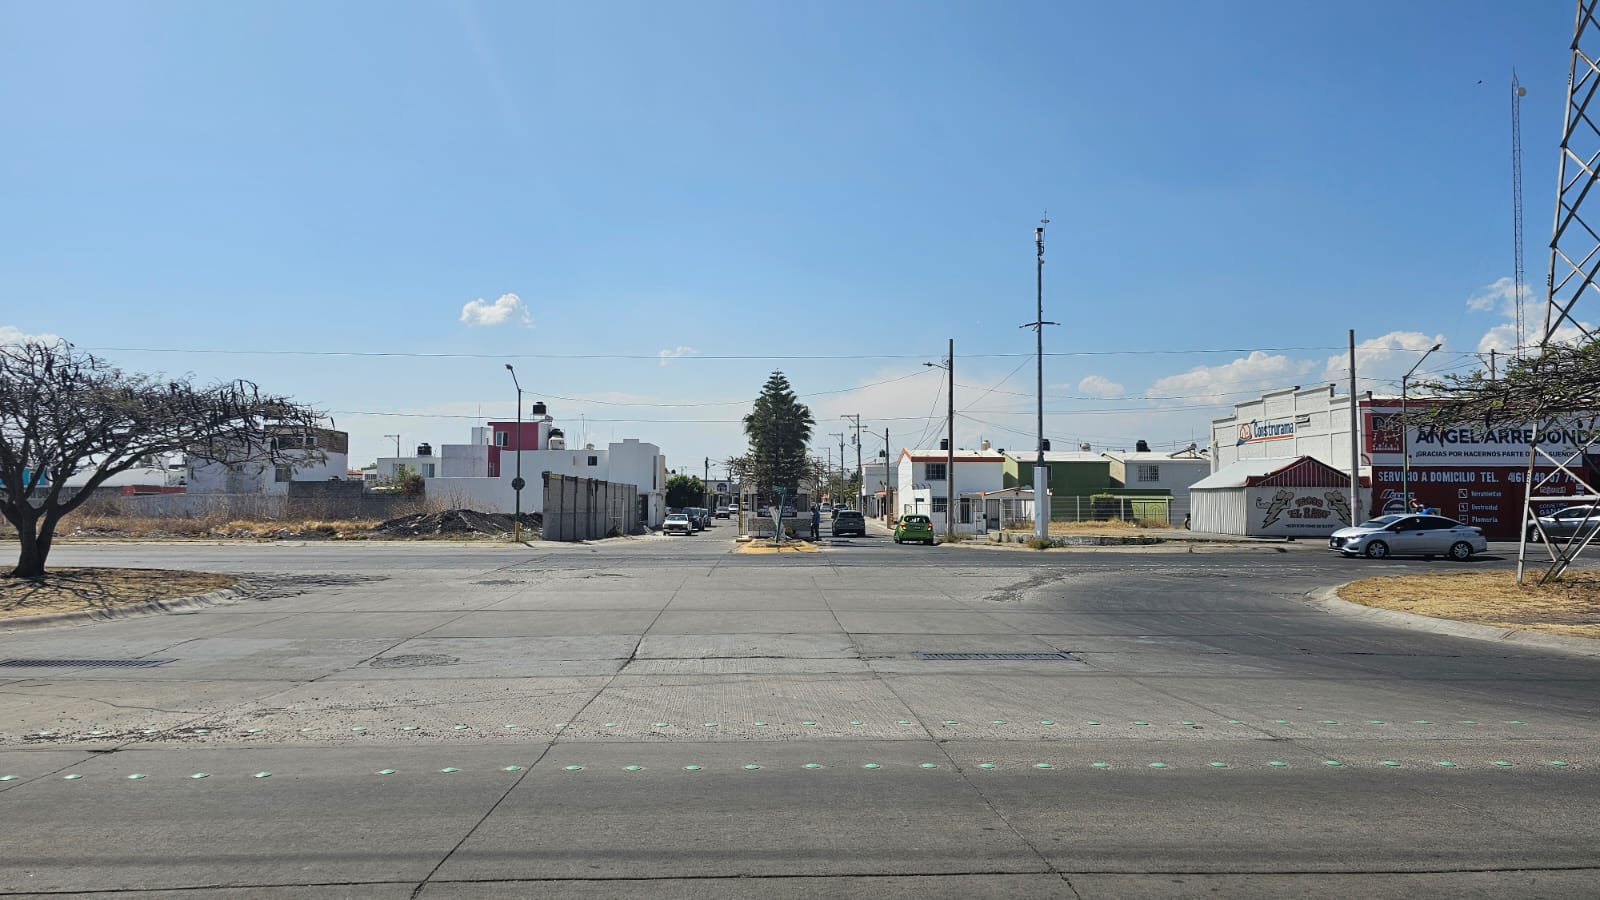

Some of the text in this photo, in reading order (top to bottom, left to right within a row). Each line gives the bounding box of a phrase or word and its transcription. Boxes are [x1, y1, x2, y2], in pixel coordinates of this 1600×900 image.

[1254, 422, 1293, 437] Construrama
[1484, 428, 1600, 444] ARREDOND
[1421, 472, 1428, 482] A
[1430, 472, 1475, 482] DOMICILIO
[1480, 472, 1499, 483] TEL.
